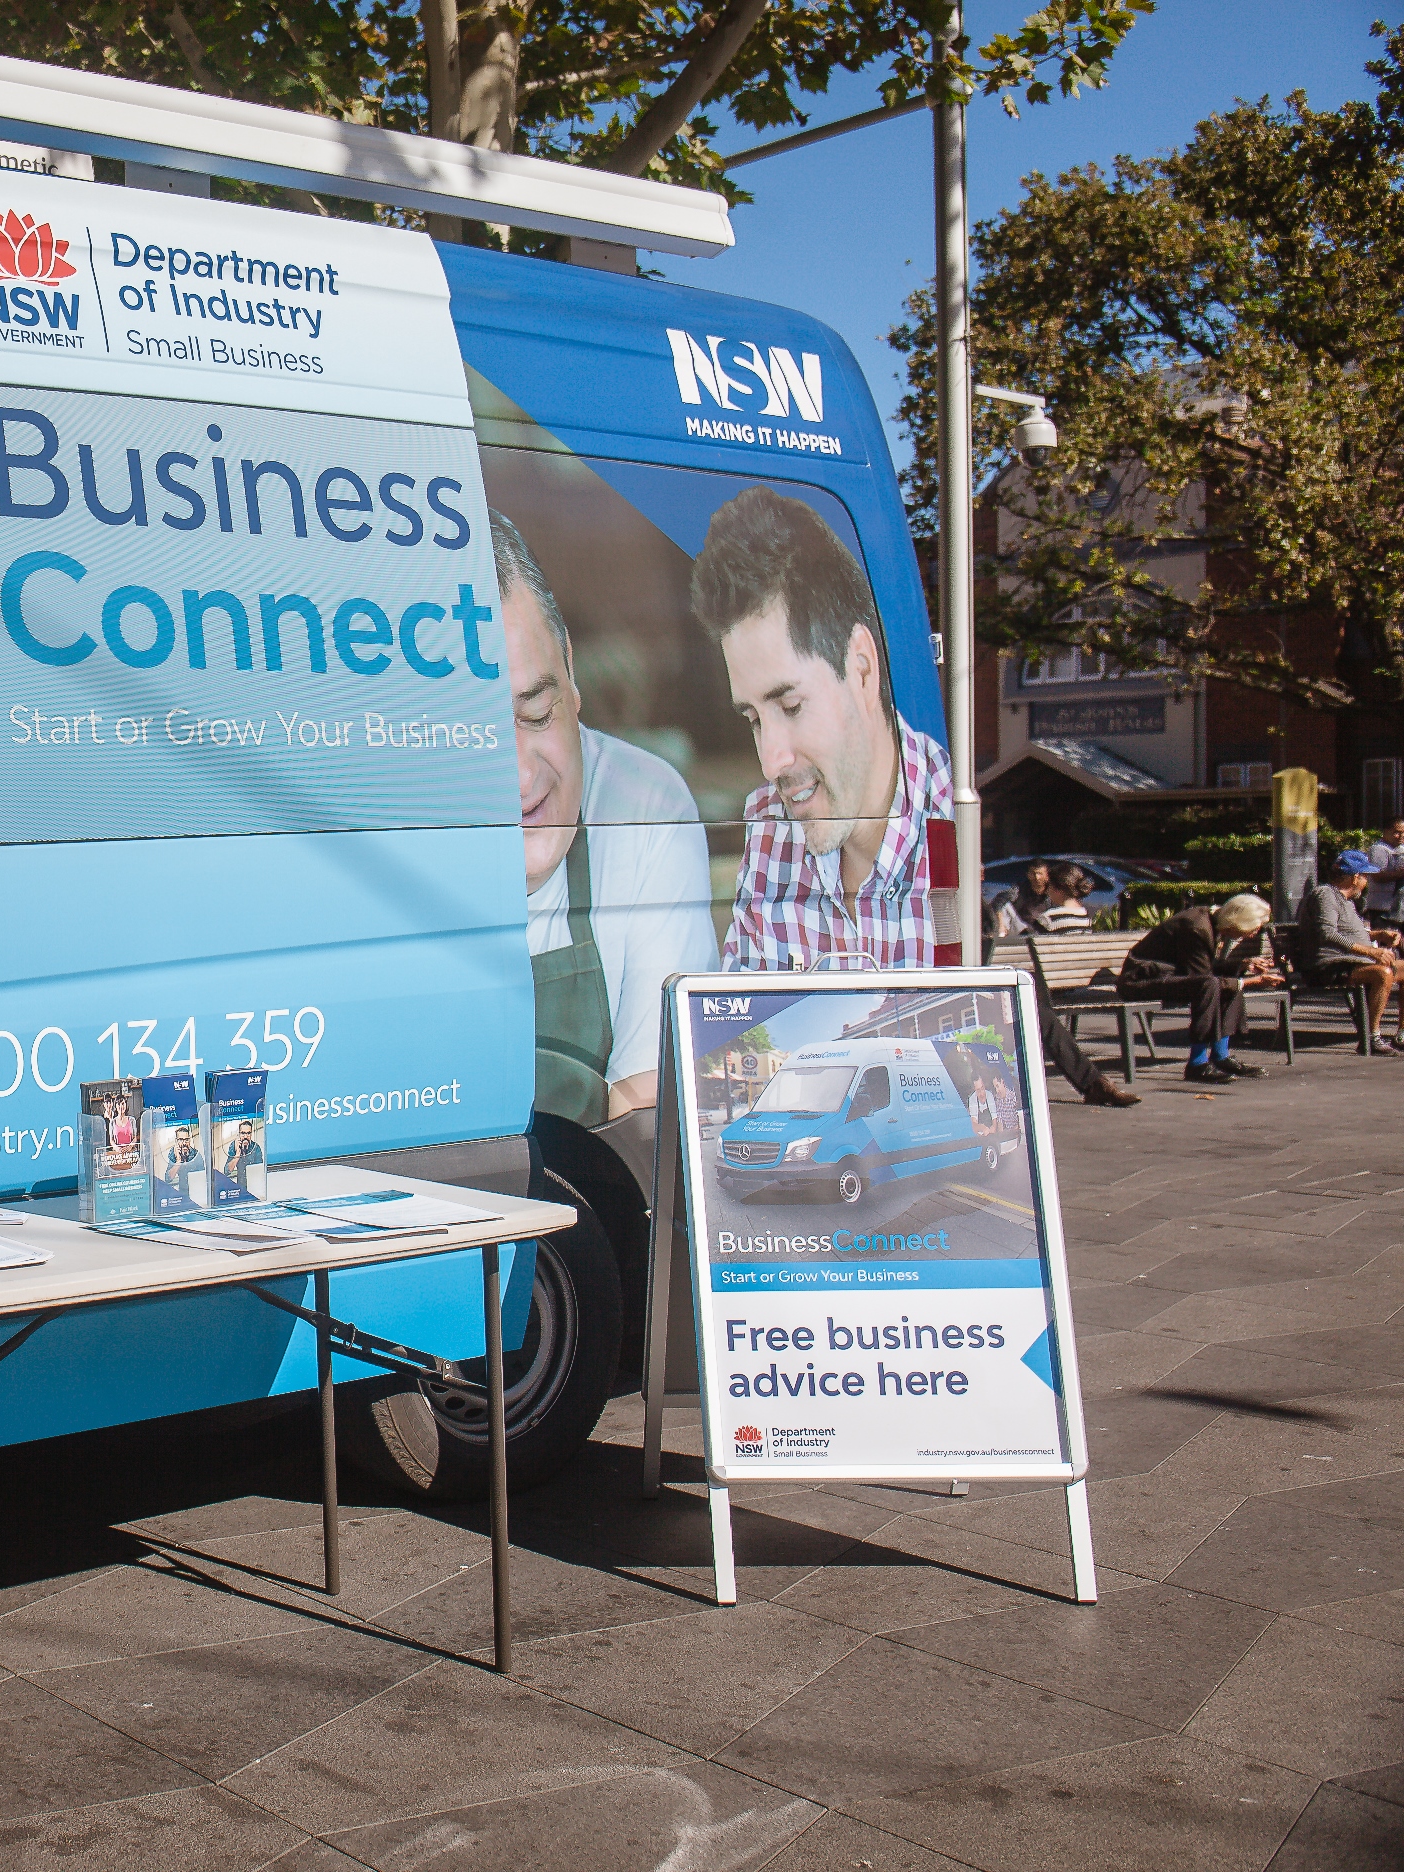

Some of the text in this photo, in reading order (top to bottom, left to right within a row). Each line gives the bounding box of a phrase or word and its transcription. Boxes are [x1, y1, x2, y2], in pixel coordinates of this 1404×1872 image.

[111, 232, 339, 295] Department
[119, 280, 322, 338] of Industry
[127, 330, 324, 374] Small Business
[666, 328, 823, 422] NSW
[686, 416, 842, 456] MAKING IT HAPPEN
[0, 550, 499, 680] Connect
[8, 705, 498, 749] Start or Grow Your Business
[702, 997, 752, 1015] NSW
[96, 1016, 203, 1079] 134
[225, 1006, 325, 1073] 359
[745, 1058, 755, 1067] 40
[899, 1073, 941, 1087] Business
[902, 1089, 945, 1103] Connect
[718, 1229, 950, 1253] BusinessConnect
[722, 1268, 919, 1283] Start or Grow Your Business
[726, 1316, 1005, 1351] Free business
[728, 1362, 969, 1397] advice here
[772, 1427, 836, 1438] Department
[772, 1438, 830, 1448] of Industry
[735, 1444, 763, 1453] NSW
[773, 1450, 828, 1458] Small Business
